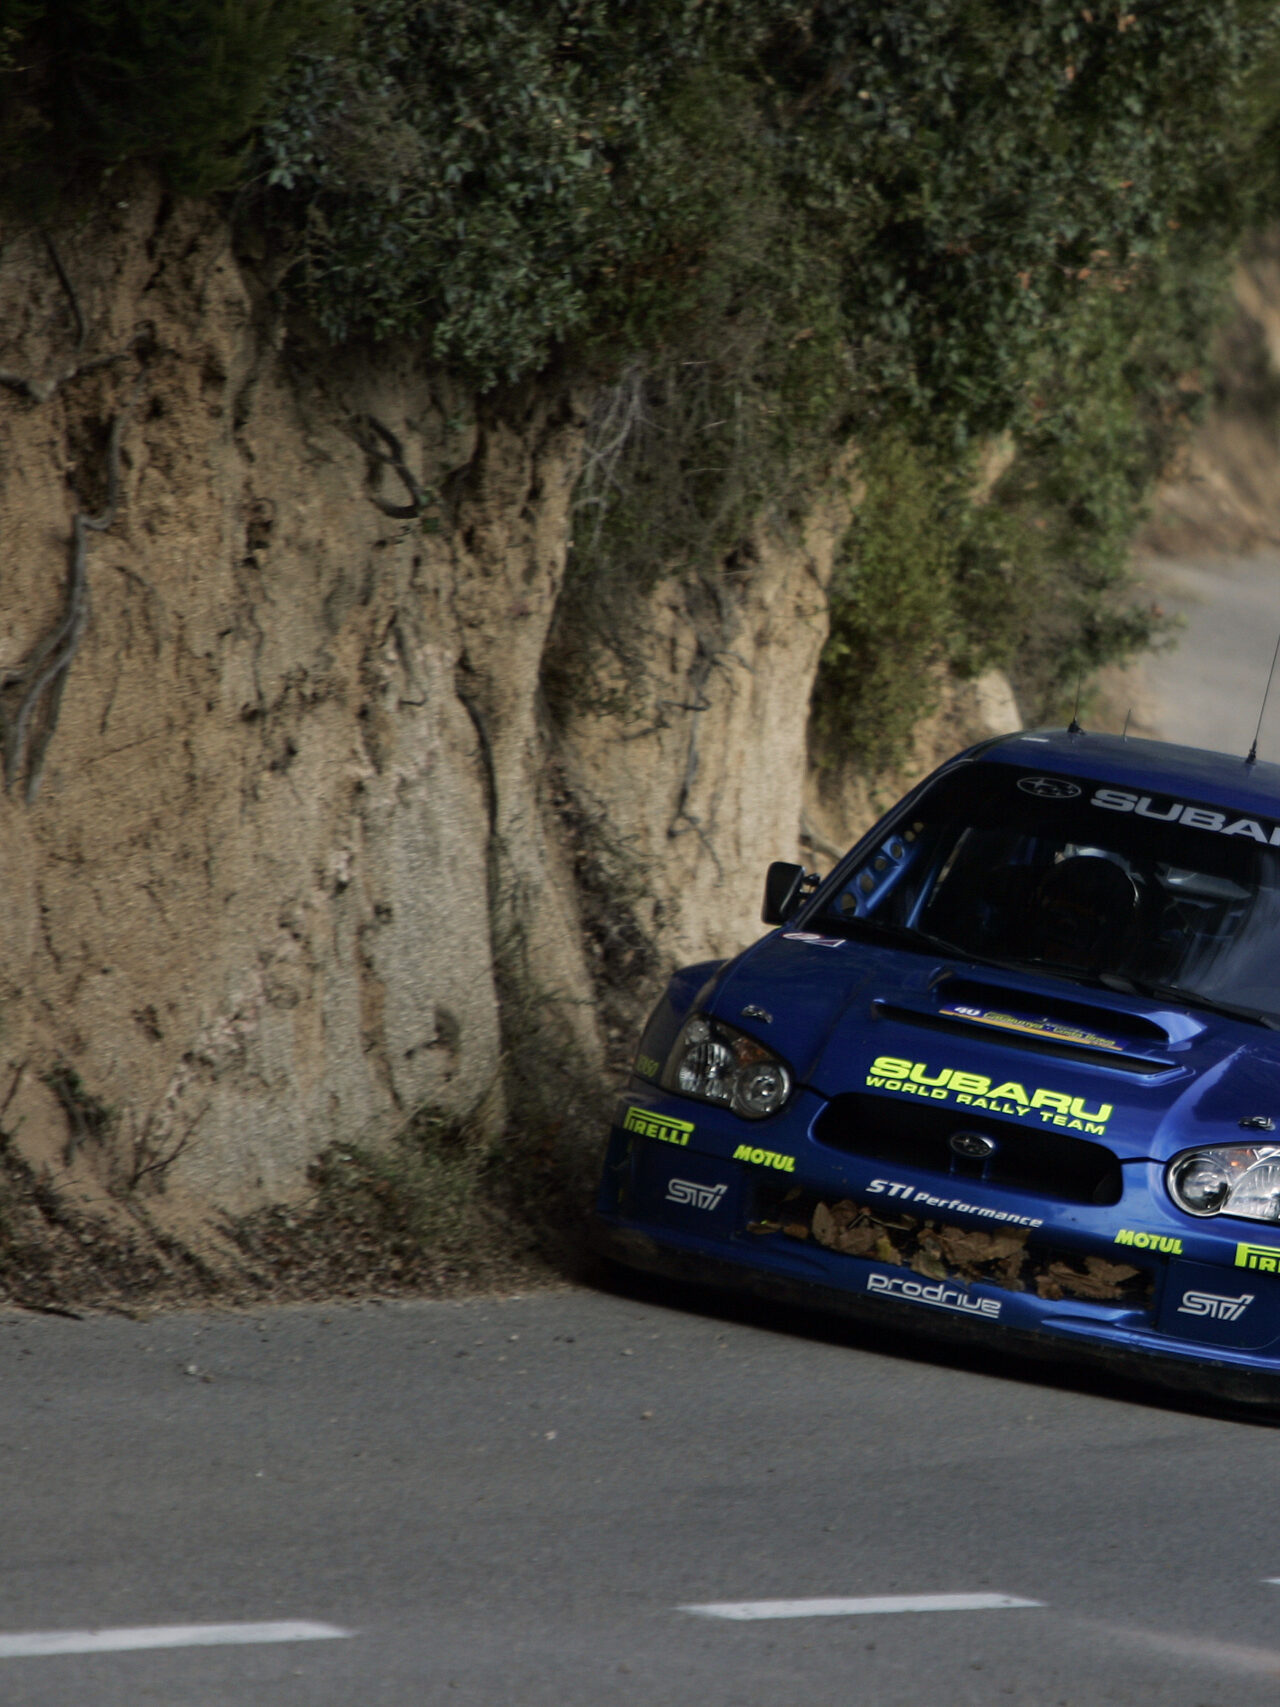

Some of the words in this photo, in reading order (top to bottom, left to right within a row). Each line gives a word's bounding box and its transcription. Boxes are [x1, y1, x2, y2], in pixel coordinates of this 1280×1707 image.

[865, 1075, 949, 1100] WORLD
[956, 1093, 1031, 1117] RALLY
[1039, 1111, 1107, 1136] TEAM
[869, 1056, 1114, 1123] SUBARU
[623, 1106, 696, 1147] PIRELLI
[732, 1144, 796, 1173] MOTUL
[865, 1178, 916, 1200] STI
[913, 1191, 1045, 1228] Performance
[1113, 1228, 1184, 1256] MOTUL
[866, 1273, 1003, 1318] prodrive
